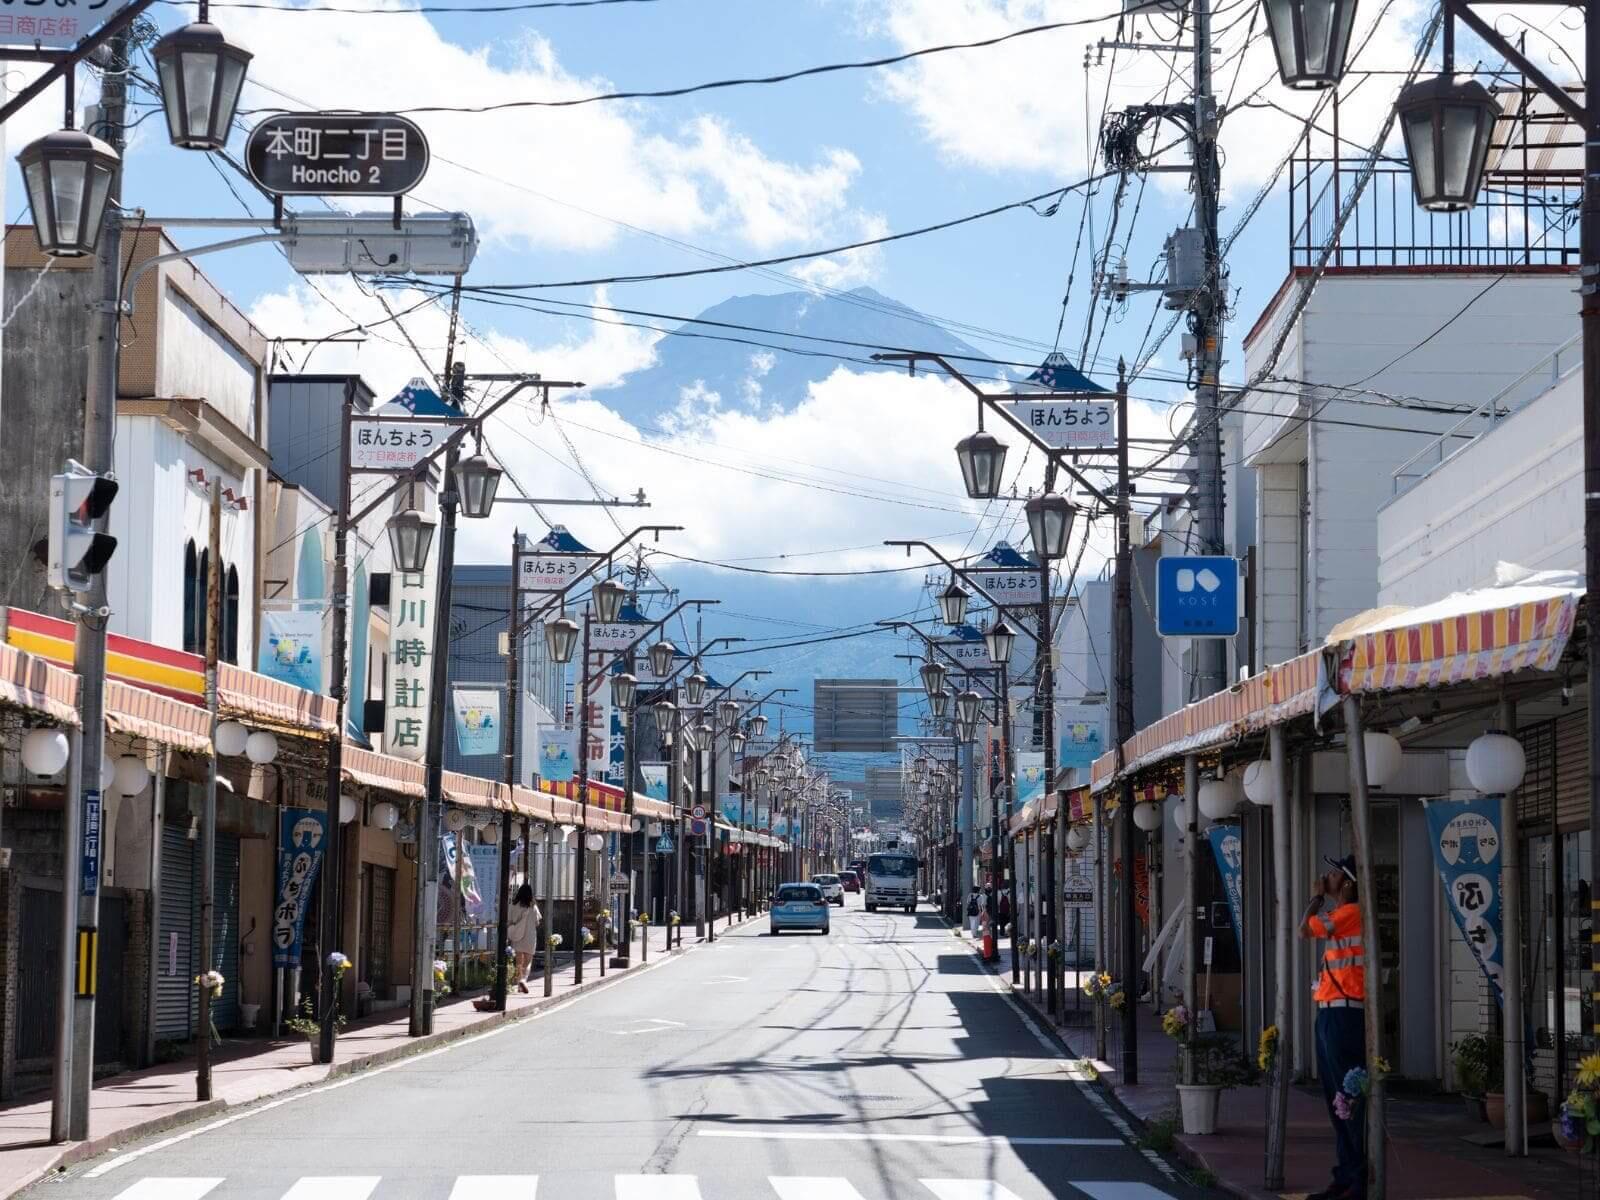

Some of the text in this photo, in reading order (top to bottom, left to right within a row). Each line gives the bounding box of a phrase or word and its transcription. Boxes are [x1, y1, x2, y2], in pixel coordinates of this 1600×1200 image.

[265, 127, 406, 160] 本町二丁目
[292, 165, 381, 184] Honcho 2
[1030, 407, 1110, 426] ほんちょう
[358, 428, 433, 447] ほんちょう
[523, 561, 577, 574] ほんちょう
[985, 577, 1038, 589] ほんちょう
[593, 628, 637, 640] ほんちょう
[956, 648, 988, 658] ほんちょ
[695, 809, 703, 817] 40
